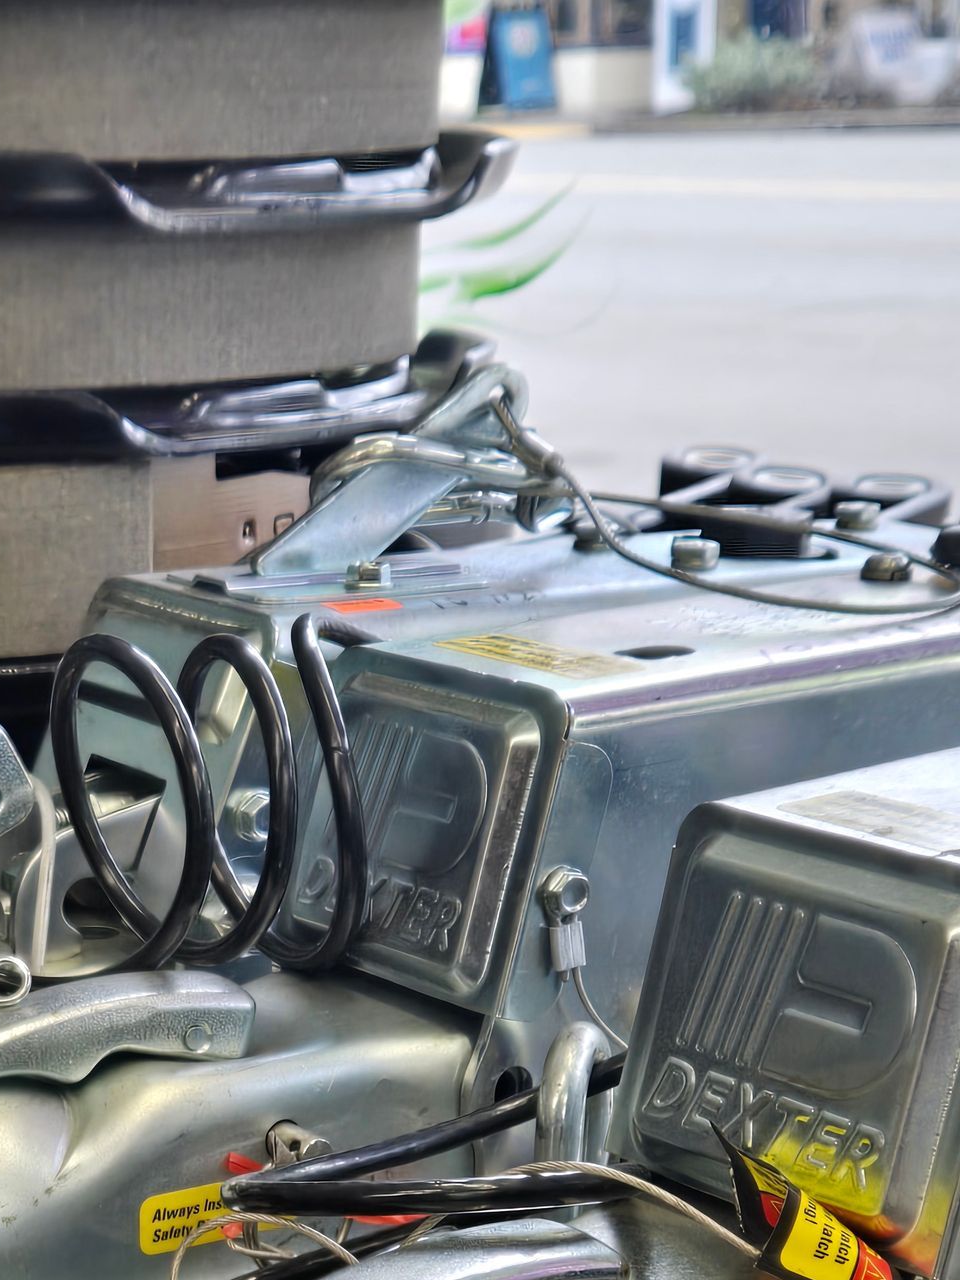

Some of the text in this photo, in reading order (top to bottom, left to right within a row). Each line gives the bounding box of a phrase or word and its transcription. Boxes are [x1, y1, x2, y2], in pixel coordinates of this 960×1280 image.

[642, 1055, 886, 1193] DEXTER
[152, 1203, 200, 1224] Always
[813, 1223, 836, 1260] latch
[834, 1230, 852, 1265] latch
